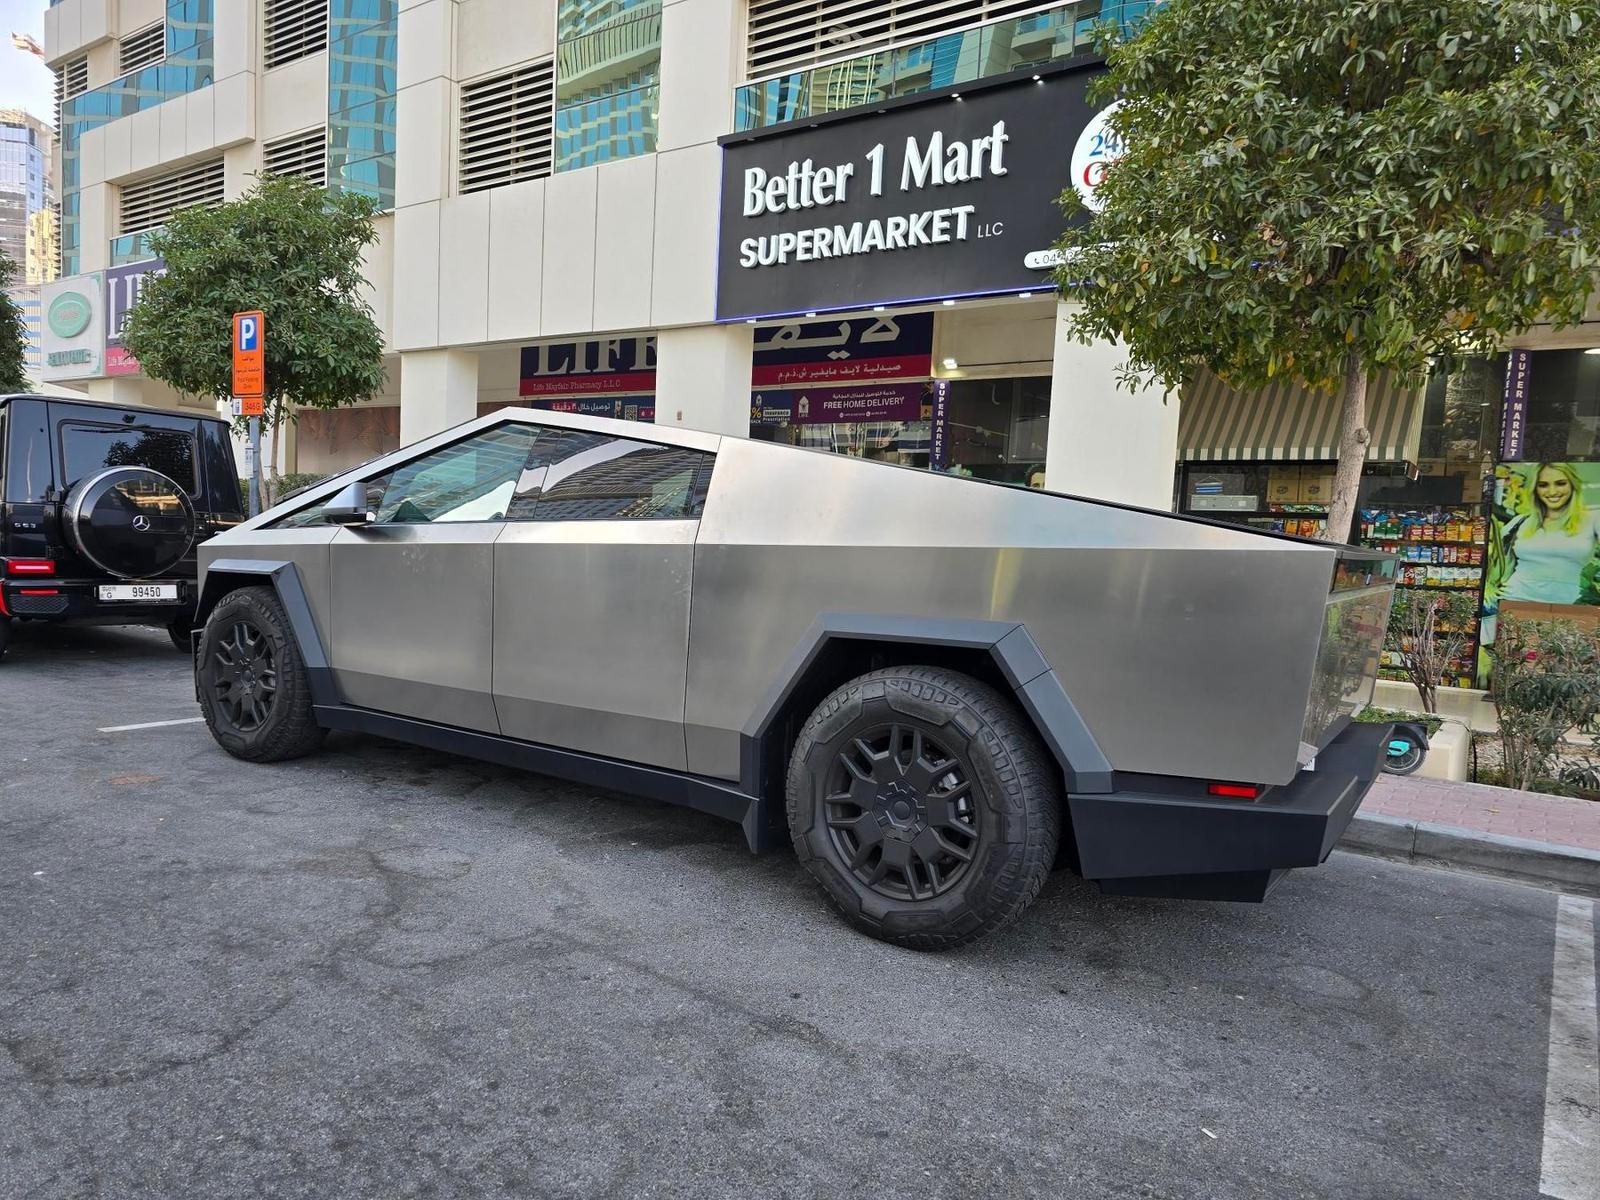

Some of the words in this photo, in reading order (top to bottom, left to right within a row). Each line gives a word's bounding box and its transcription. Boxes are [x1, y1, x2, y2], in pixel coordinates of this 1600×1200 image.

[743, 158, 854, 217] Better
[865, 143, 885, 197] 1
[900, 120, 1009, 192] Mart
[740, 205, 976, 269] SUPERMARKET
[977, 222, 1004, 239] LLC
[241, 318, 255, 350] P
[570, 381, 602, 391] Pharmacy
[1516, 353, 1527, 398] SUPER
[823, 401, 842, 409] FREE
[843, 400, 866, 409] HOME
[867, 396, 905, 407] DELIVERY
[937, 382, 946, 417] SUPER
[935, 420, 944, 460] MARKET
[1510, 403, 1523, 457] MARKET
[132, 586, 161, 597] 99450
